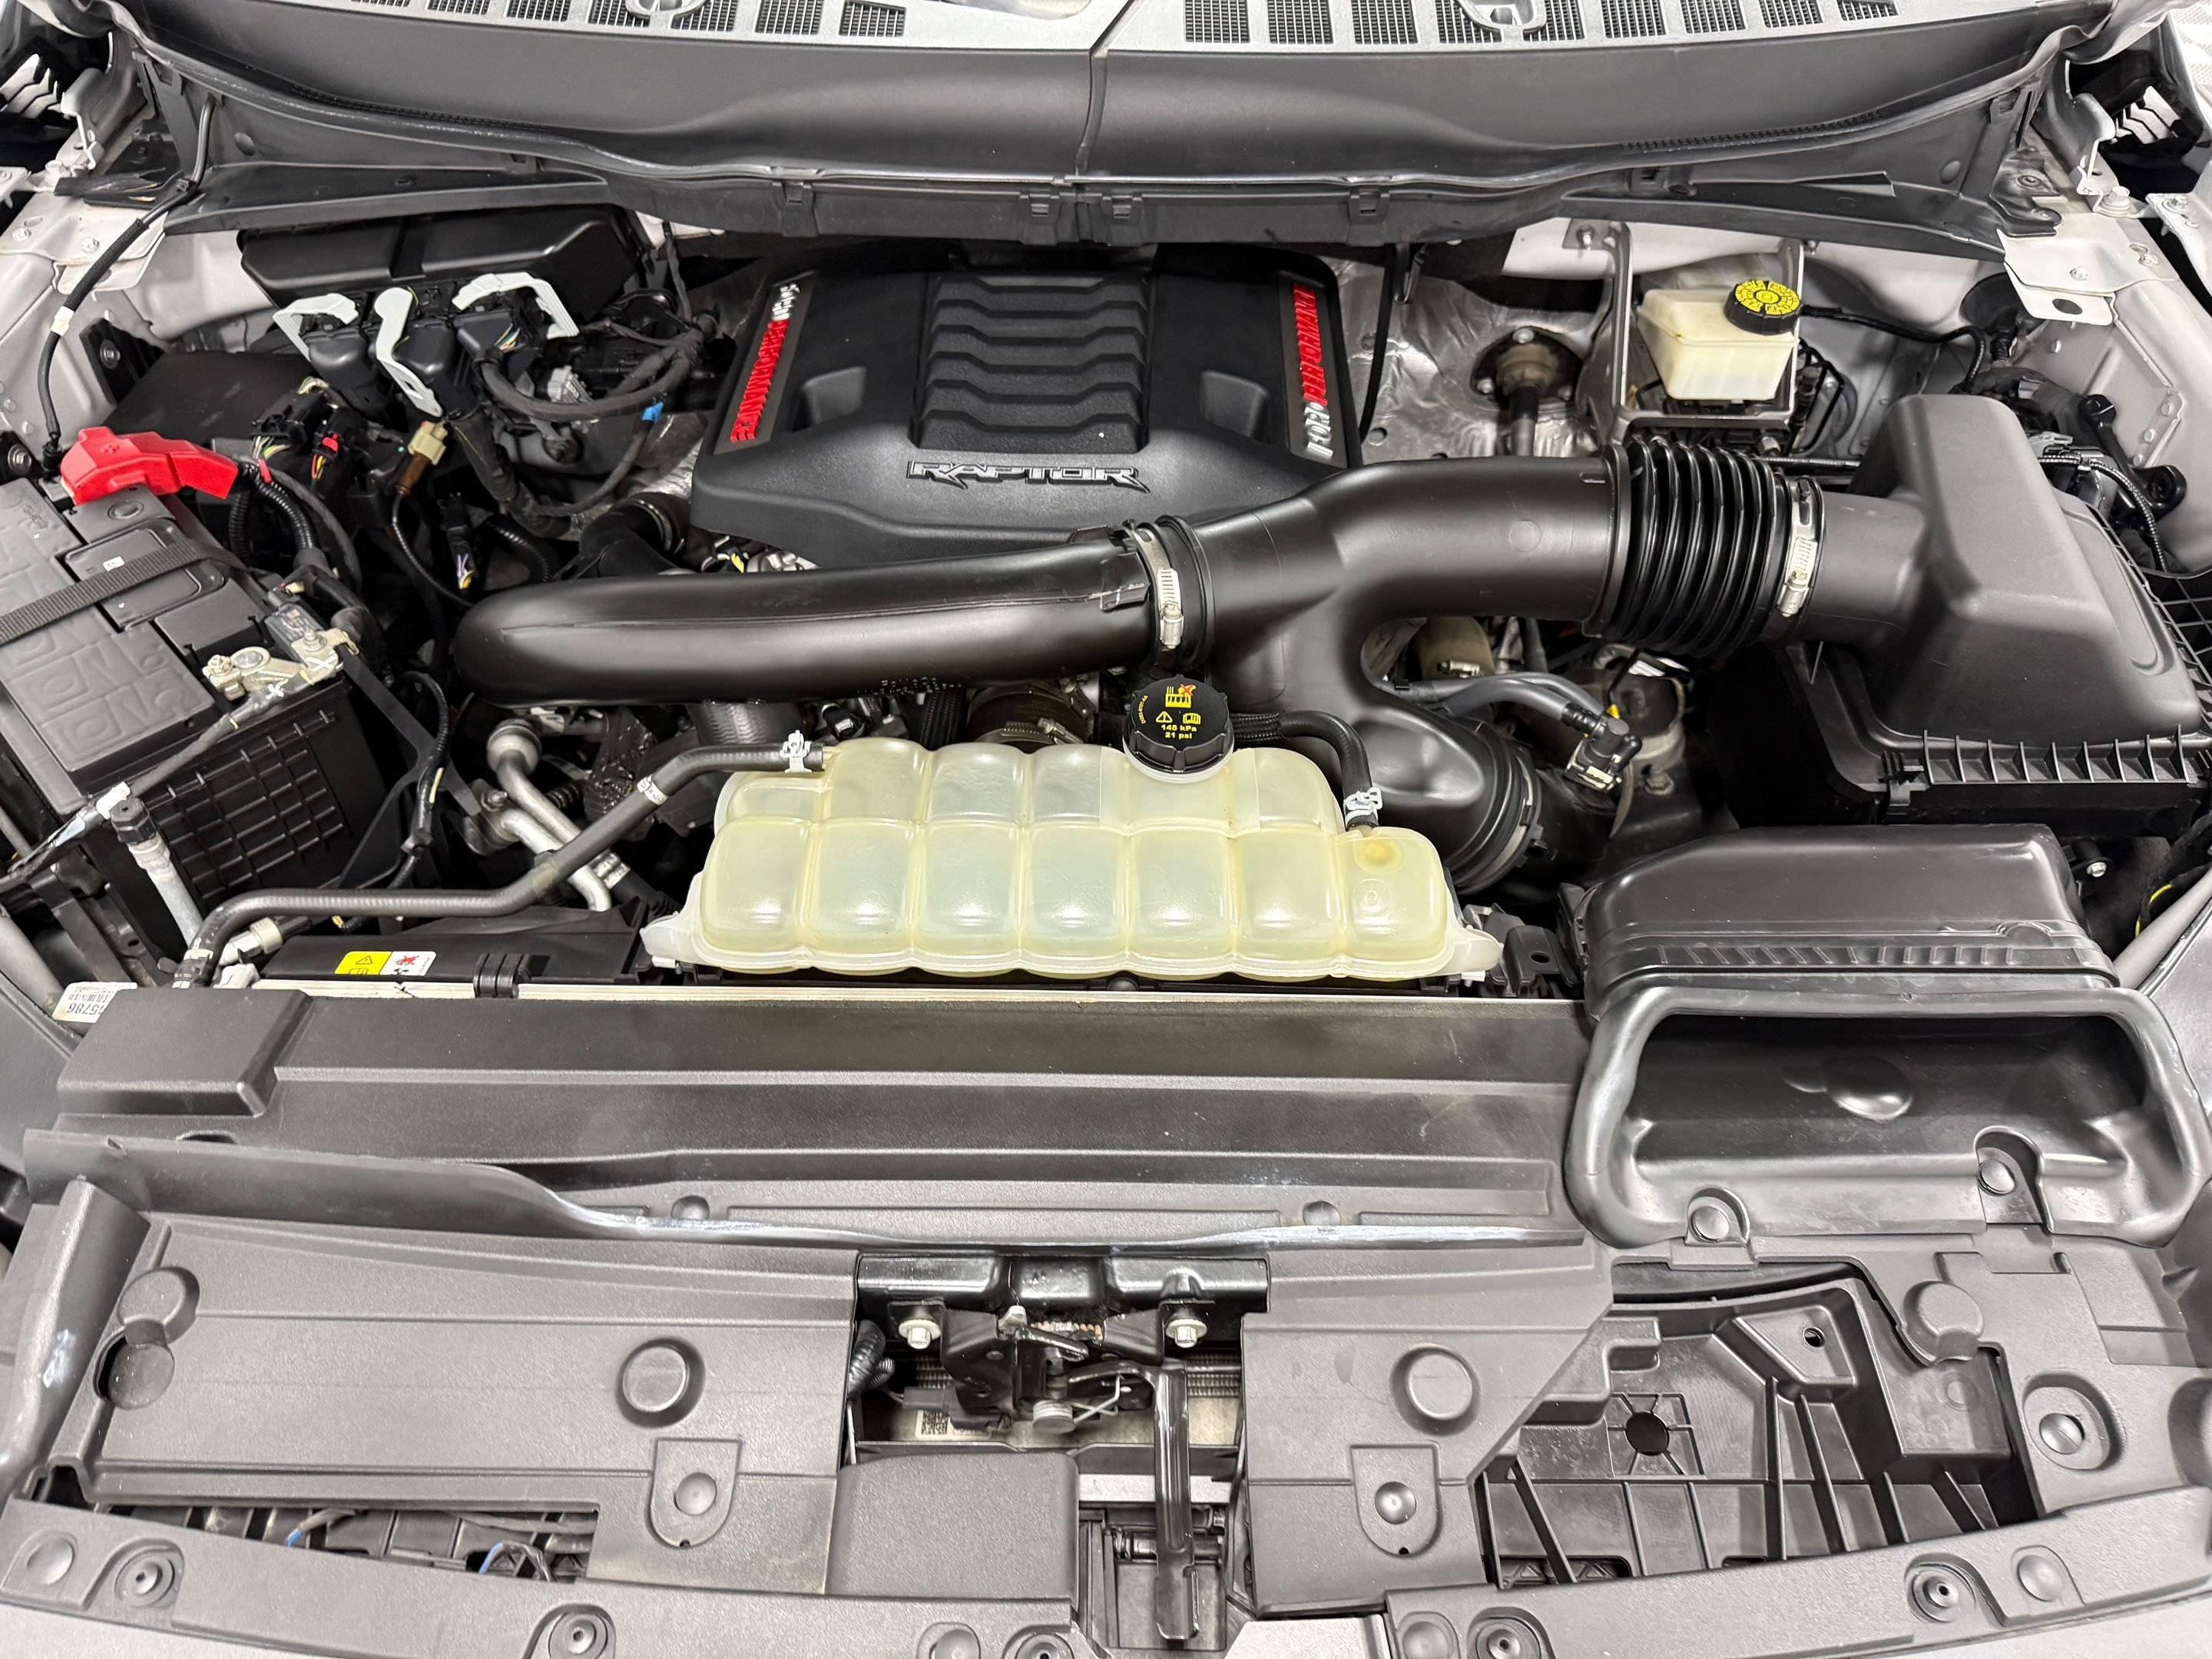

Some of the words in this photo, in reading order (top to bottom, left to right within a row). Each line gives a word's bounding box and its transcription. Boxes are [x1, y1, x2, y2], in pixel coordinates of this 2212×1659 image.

[730, 320, 790, 442] PERFORMANCE
[1293, 284, 1328, 406] PERFORMANCE
[1304, 401, 1333, 459] FORD
[906, 461, 1151, 493] RAPTOR
